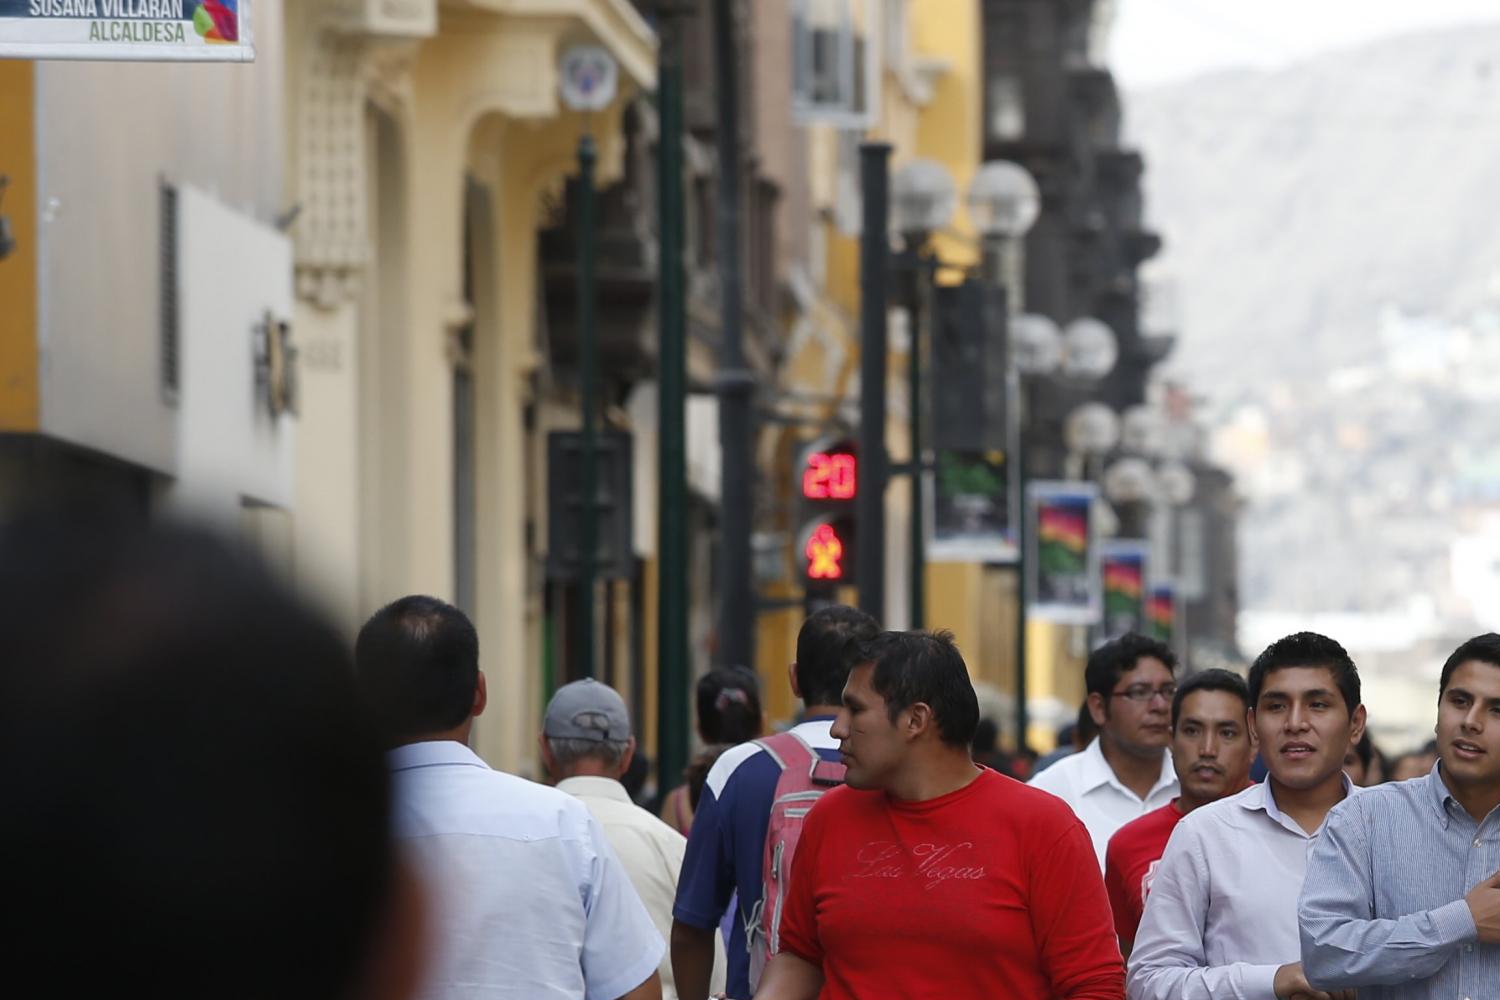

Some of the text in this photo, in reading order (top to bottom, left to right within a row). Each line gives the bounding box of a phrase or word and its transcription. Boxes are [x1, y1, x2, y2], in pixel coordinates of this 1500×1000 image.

[29, 0, 98, 17] SUSANA
[89, 20, 186, 43] ALCALDESA
[803, 453, 856, 499] 20
[851, 840, 986, 891] Las Vegas
